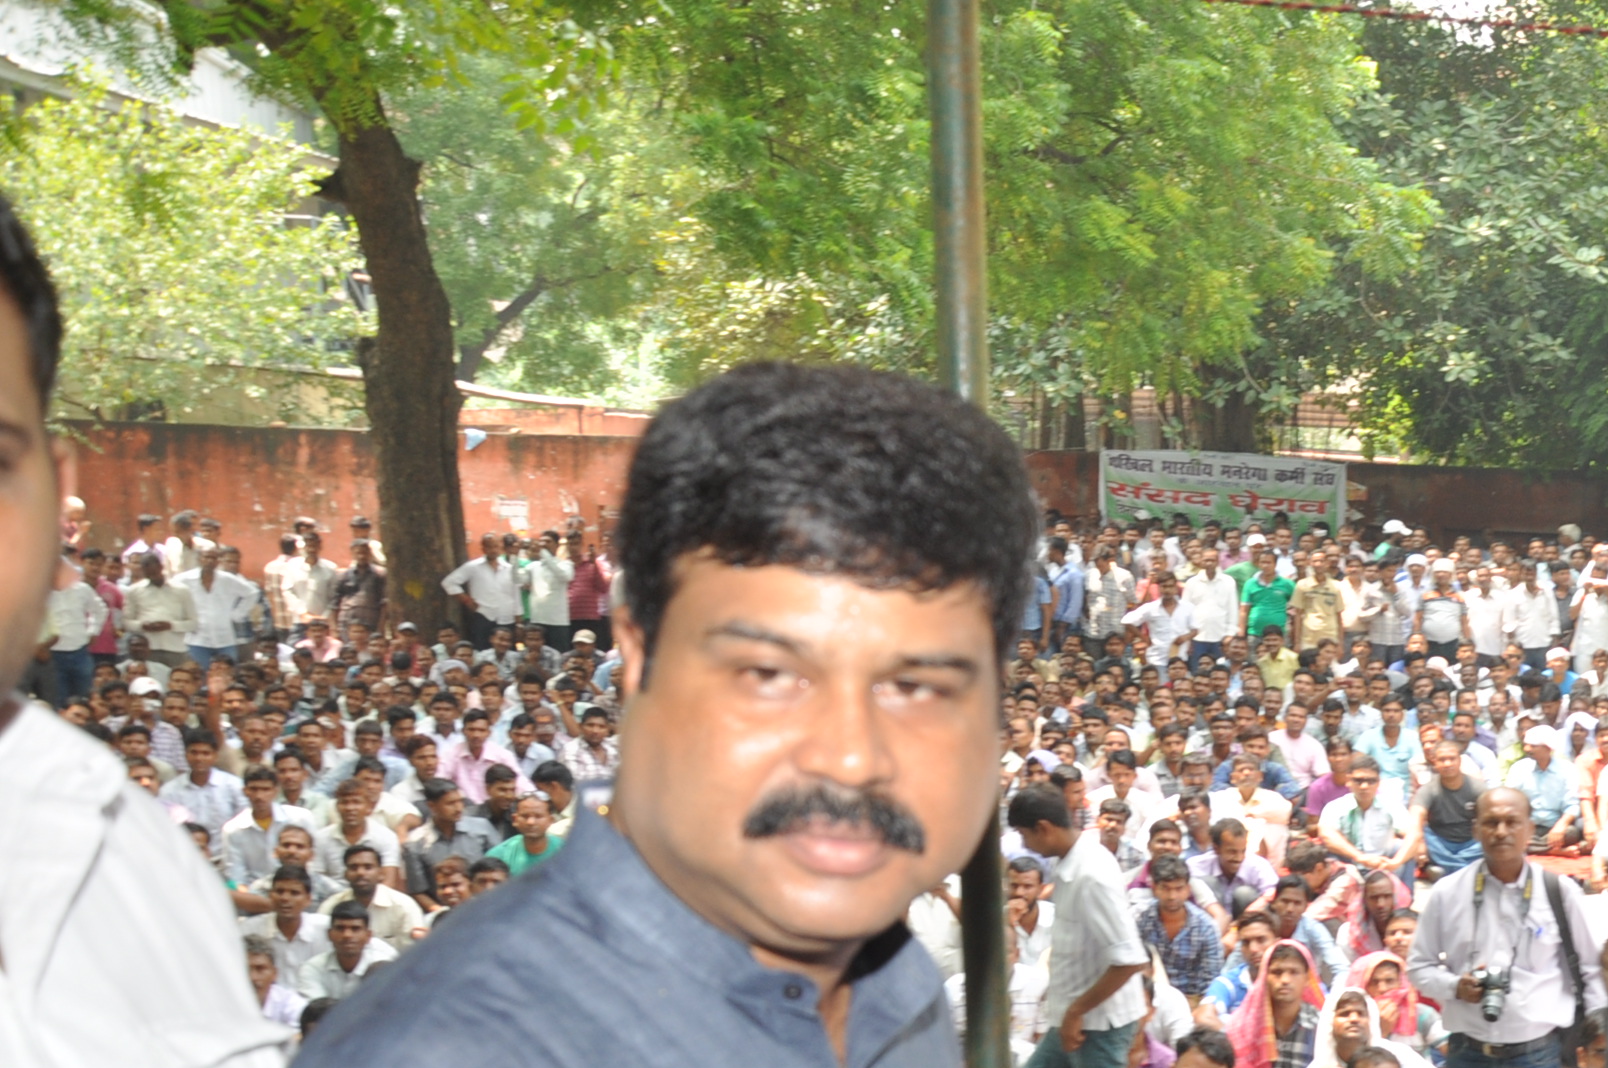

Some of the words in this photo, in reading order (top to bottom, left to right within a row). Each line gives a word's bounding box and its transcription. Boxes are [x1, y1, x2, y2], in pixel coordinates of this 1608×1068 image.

[1161, 458, 1213, 477] भारतीय
[1220, 462, 1267, 481] मनरेगा
[1106, 481, 1217, 507] संसद
[1227, 489, 1331, 515] घेराव
